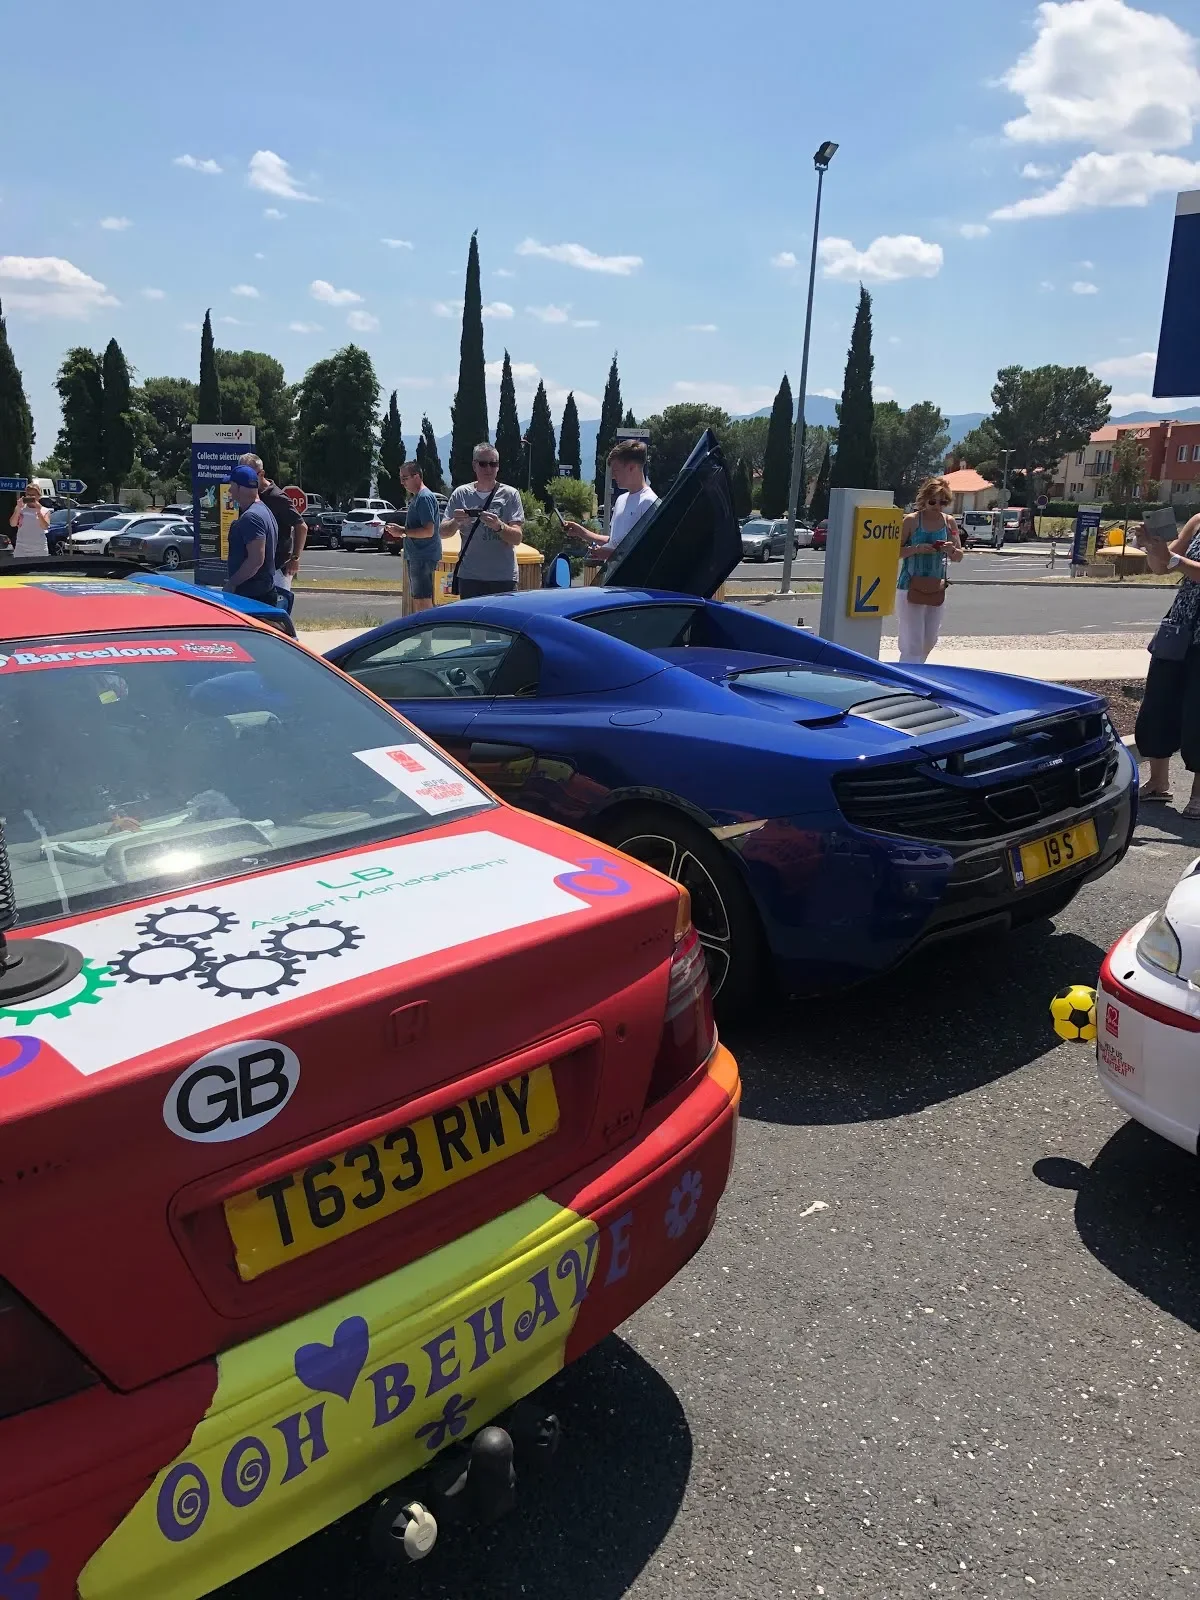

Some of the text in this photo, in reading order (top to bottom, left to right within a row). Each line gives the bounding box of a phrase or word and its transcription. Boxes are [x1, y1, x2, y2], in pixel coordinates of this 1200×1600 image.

[197, 452, 240, 461] Collecte sélectiv
[197, 463, 210, 471] Waste
[292, 498, 305, 507] OP
[863, 519, 900, 540] Sortie
[13, 645, 178, 665] Barcelona
[1043, 832, 1075, 868] 19 S
[316, 866, 394, 889] LB
[1016, 872, 1024, 882] GB
[251, 858, 509, 930] Asset Management
[176, 1047, 290, 1134] GB
[256, 1075, 531, 1247] T633 RWY
[156, 1210, 635, 1543] OOH BEHAVE
